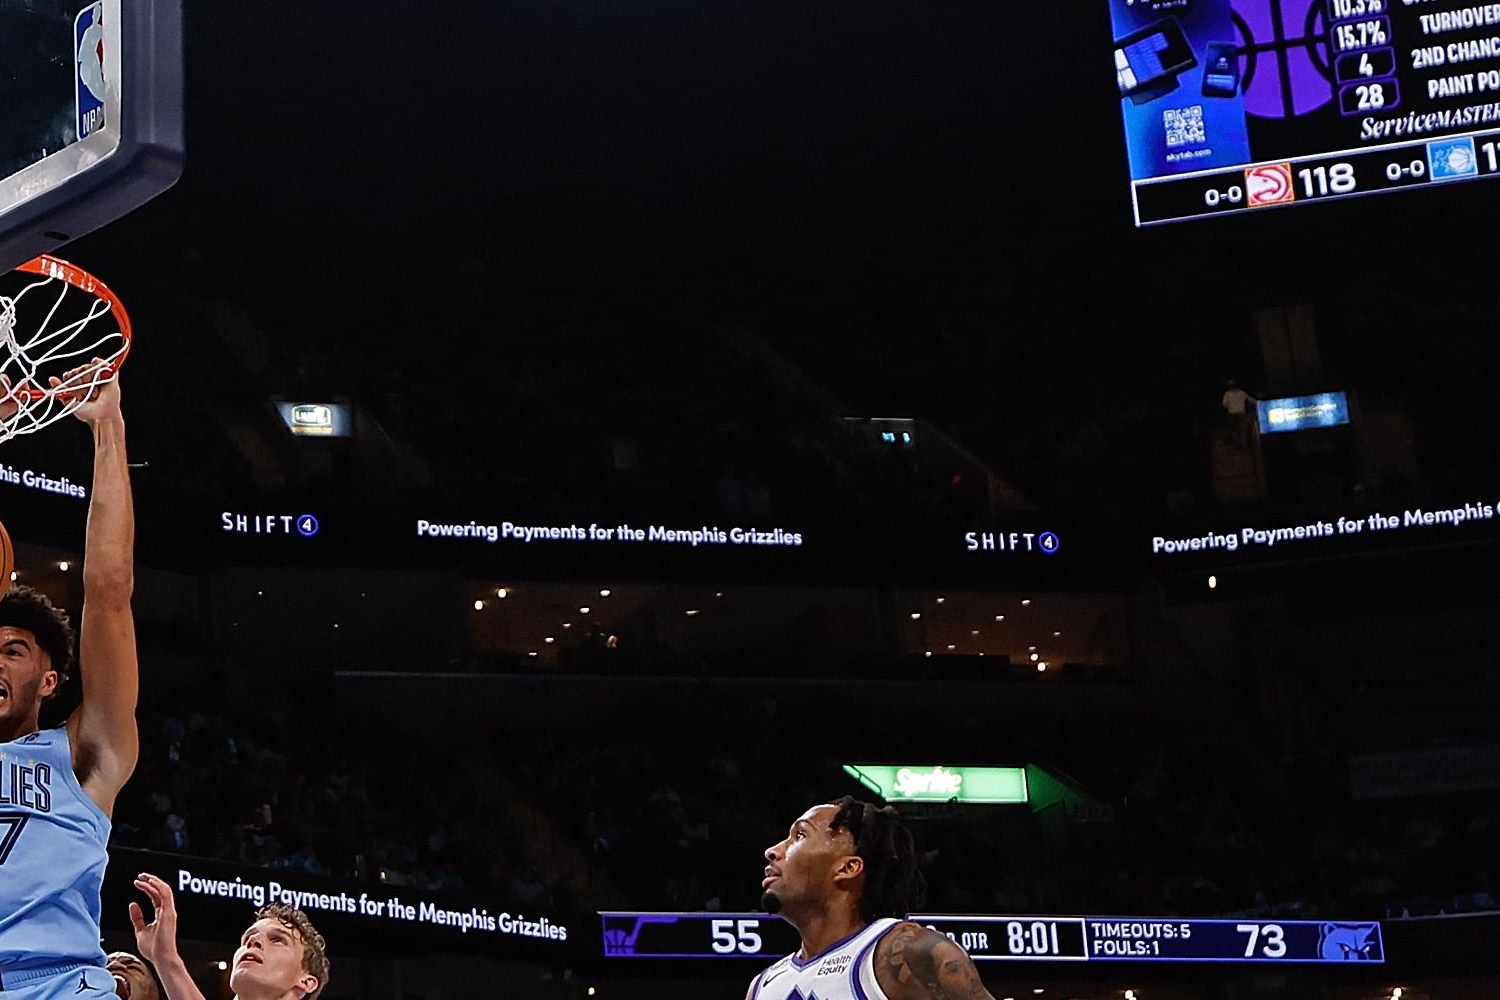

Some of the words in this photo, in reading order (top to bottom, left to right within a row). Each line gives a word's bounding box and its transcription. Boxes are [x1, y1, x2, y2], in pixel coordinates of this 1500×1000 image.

[1336, 20, 1386, 51] 15.7%
[1359, 53, 1374, 77] 4
[1411, 46, 1445, 69] 2ND
[1447, 37, 1500, 63] CHANC
[1356, 84, 1384, 111] 28
[1428, 74, 1474, 99] PAINT
[1166, 148, 1212, 162] skytab.com
[1299, 162, 1357, 198] 118
[1386, 159, 1425, 181] 0-0
[1204, 185, 1243, 206] 0-0
[22, 470, 86, 499] Grizzlies
[416, 519, 498, 541] Powering
[502, 521, 586, 544] Payments
[589, 522, 614, 541] for
[617, 524, 645, 542] the
[648, 525, 727, 548] Memphis
[730, 526, 802, 546] Grizzlies
[1152, 530, 1238, 554] Powering
[1242, 519, 1334, 549] Payments
[1337, 515, 1366, 535] for
[1368, 511, 1400, 532] the
[1403, 501, 1493, 528] Memphis
[178, 869, 264, 906] Powering
[268, 881, 357, 914] Payments
[359, 894, 385, 916] for
[387, 897, 416, 920] the
[419, 902, 496, 933] Memphis
[498, 912, 567, 941] Grizzlies
[711, 919, 763, 953] 55
[961, 932, 989, 950] QTR
[1007, 921, 1059, 954] 8:01
[1236, 924, 1287, 959] 73
[817, 964, 848, 976] Equity
[822, 955, 852, 967] Health
